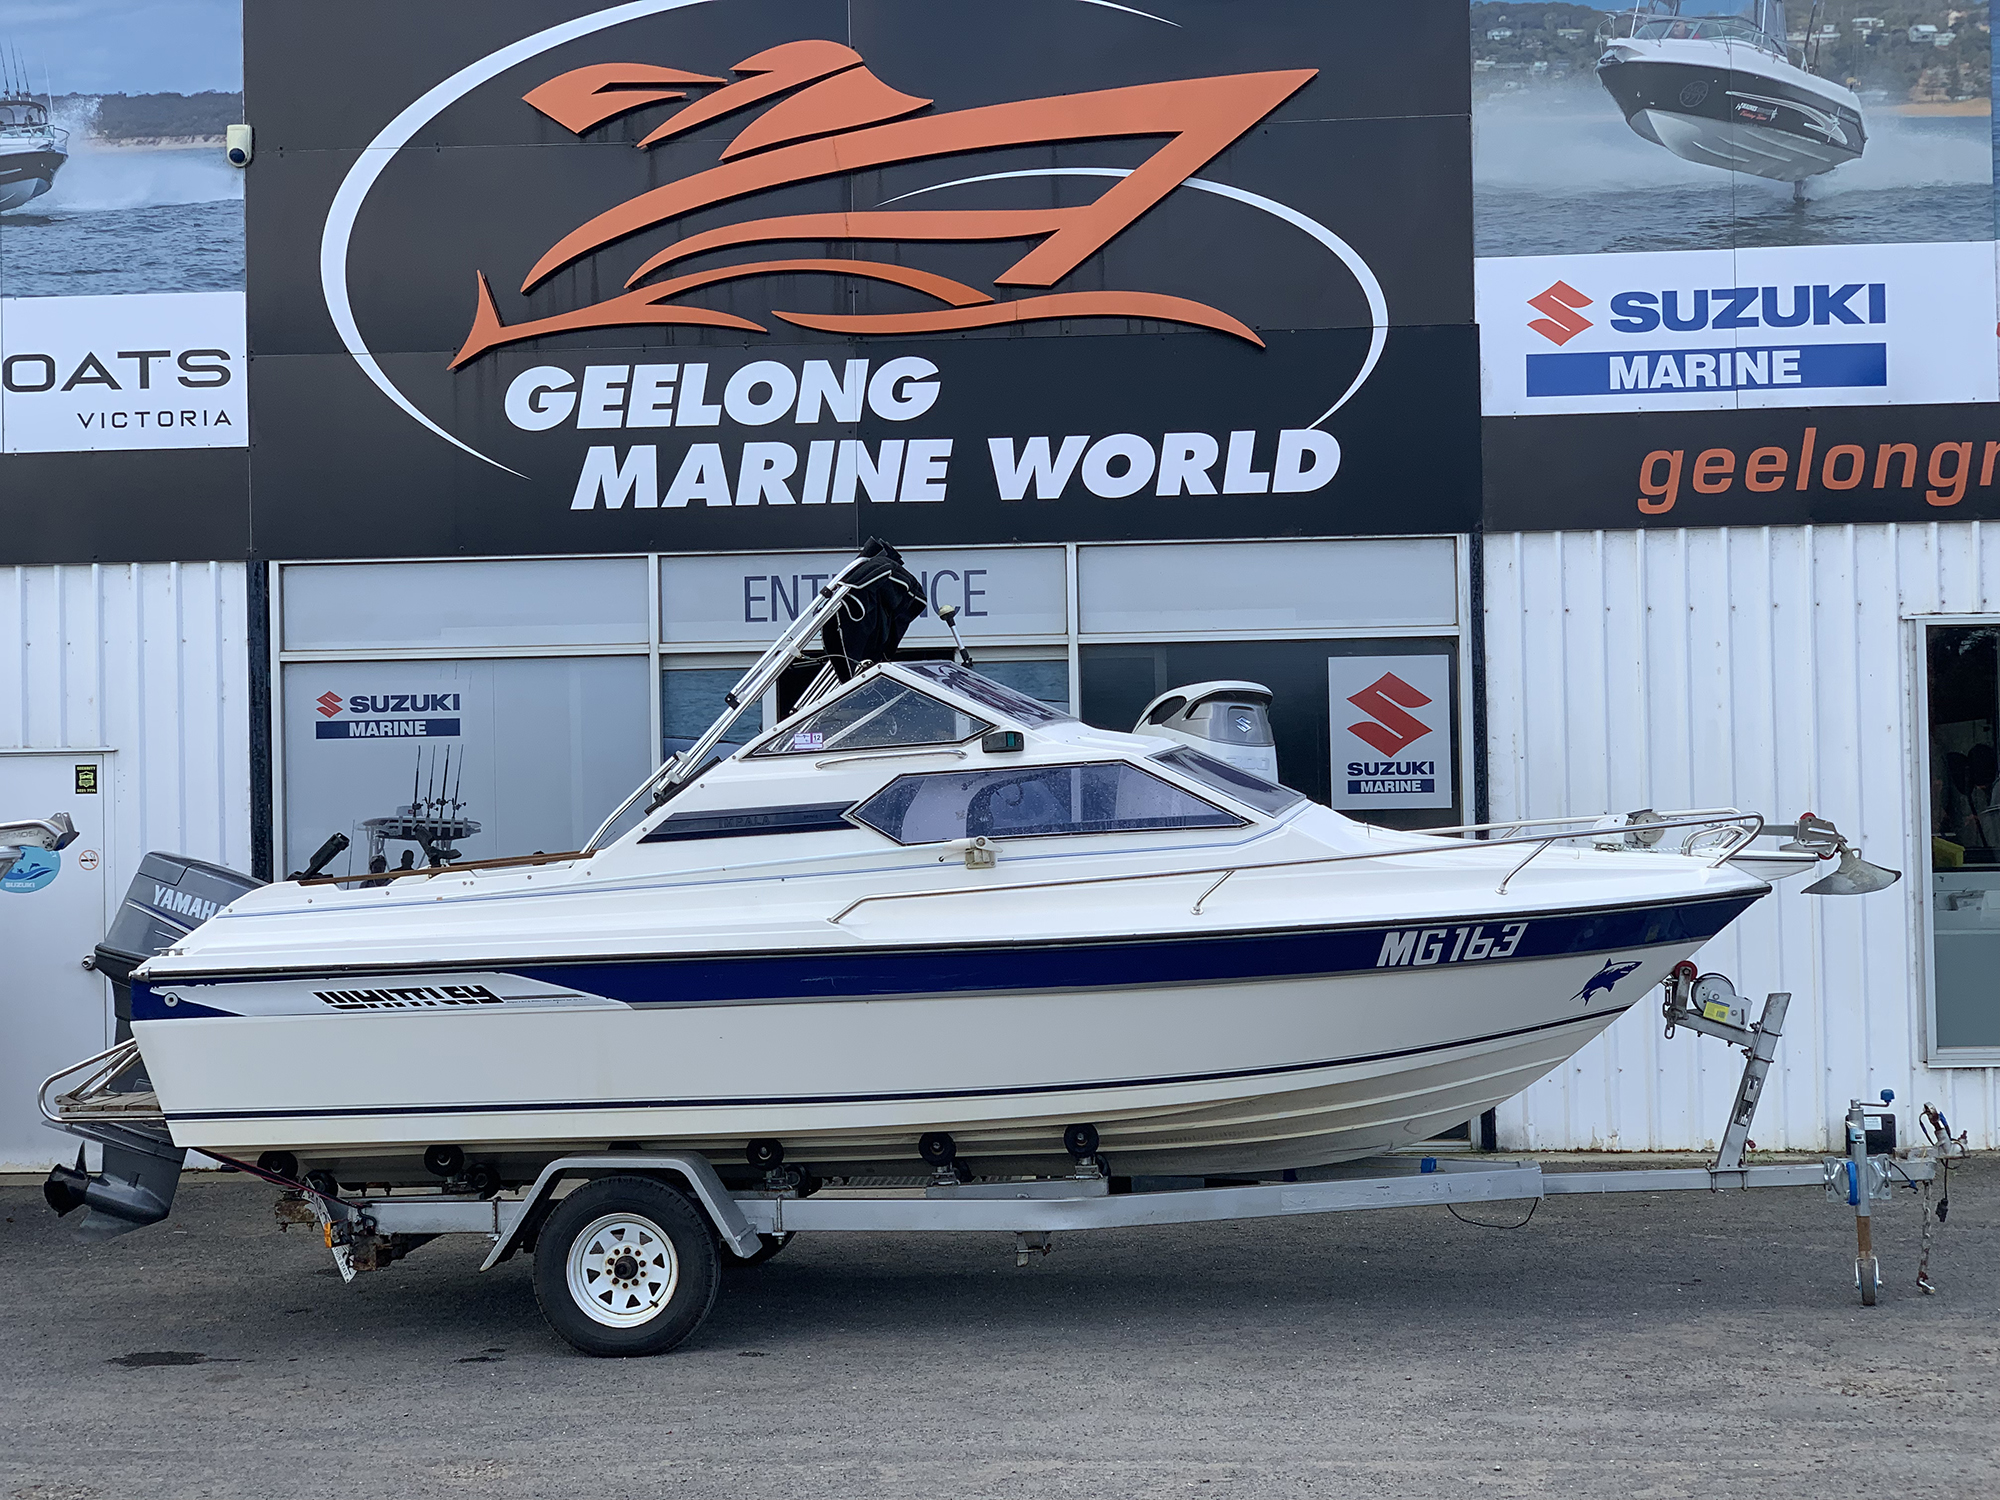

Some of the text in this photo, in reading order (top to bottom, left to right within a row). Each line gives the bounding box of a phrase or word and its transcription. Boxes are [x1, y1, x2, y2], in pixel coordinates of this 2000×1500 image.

[1610, 283, 1886, 333] SUZUKI
[2, 349, 231, 393] OATS
[1609, 350, 1801, 390] MARINE
[504, 356, 941, 431] GEELONG
[77, 409, 232, 429] VICTORIA
[571, 429, 1341, 510] MARINE WORLD
[744, 569, 988, 622] ENTCE
[349, 693, 461, 713] SUZUKI
[349, 720, 427, 737] MARINE
[1347, 761, 1435, 776] SUZUKI
[1360, 780, 1422, 793] MARINE
[718, 815, 770, 829] IMPALA
[1376, 922, 1529, 967] MG 163
[312, 984, 505, 1011] WHITTLEY
